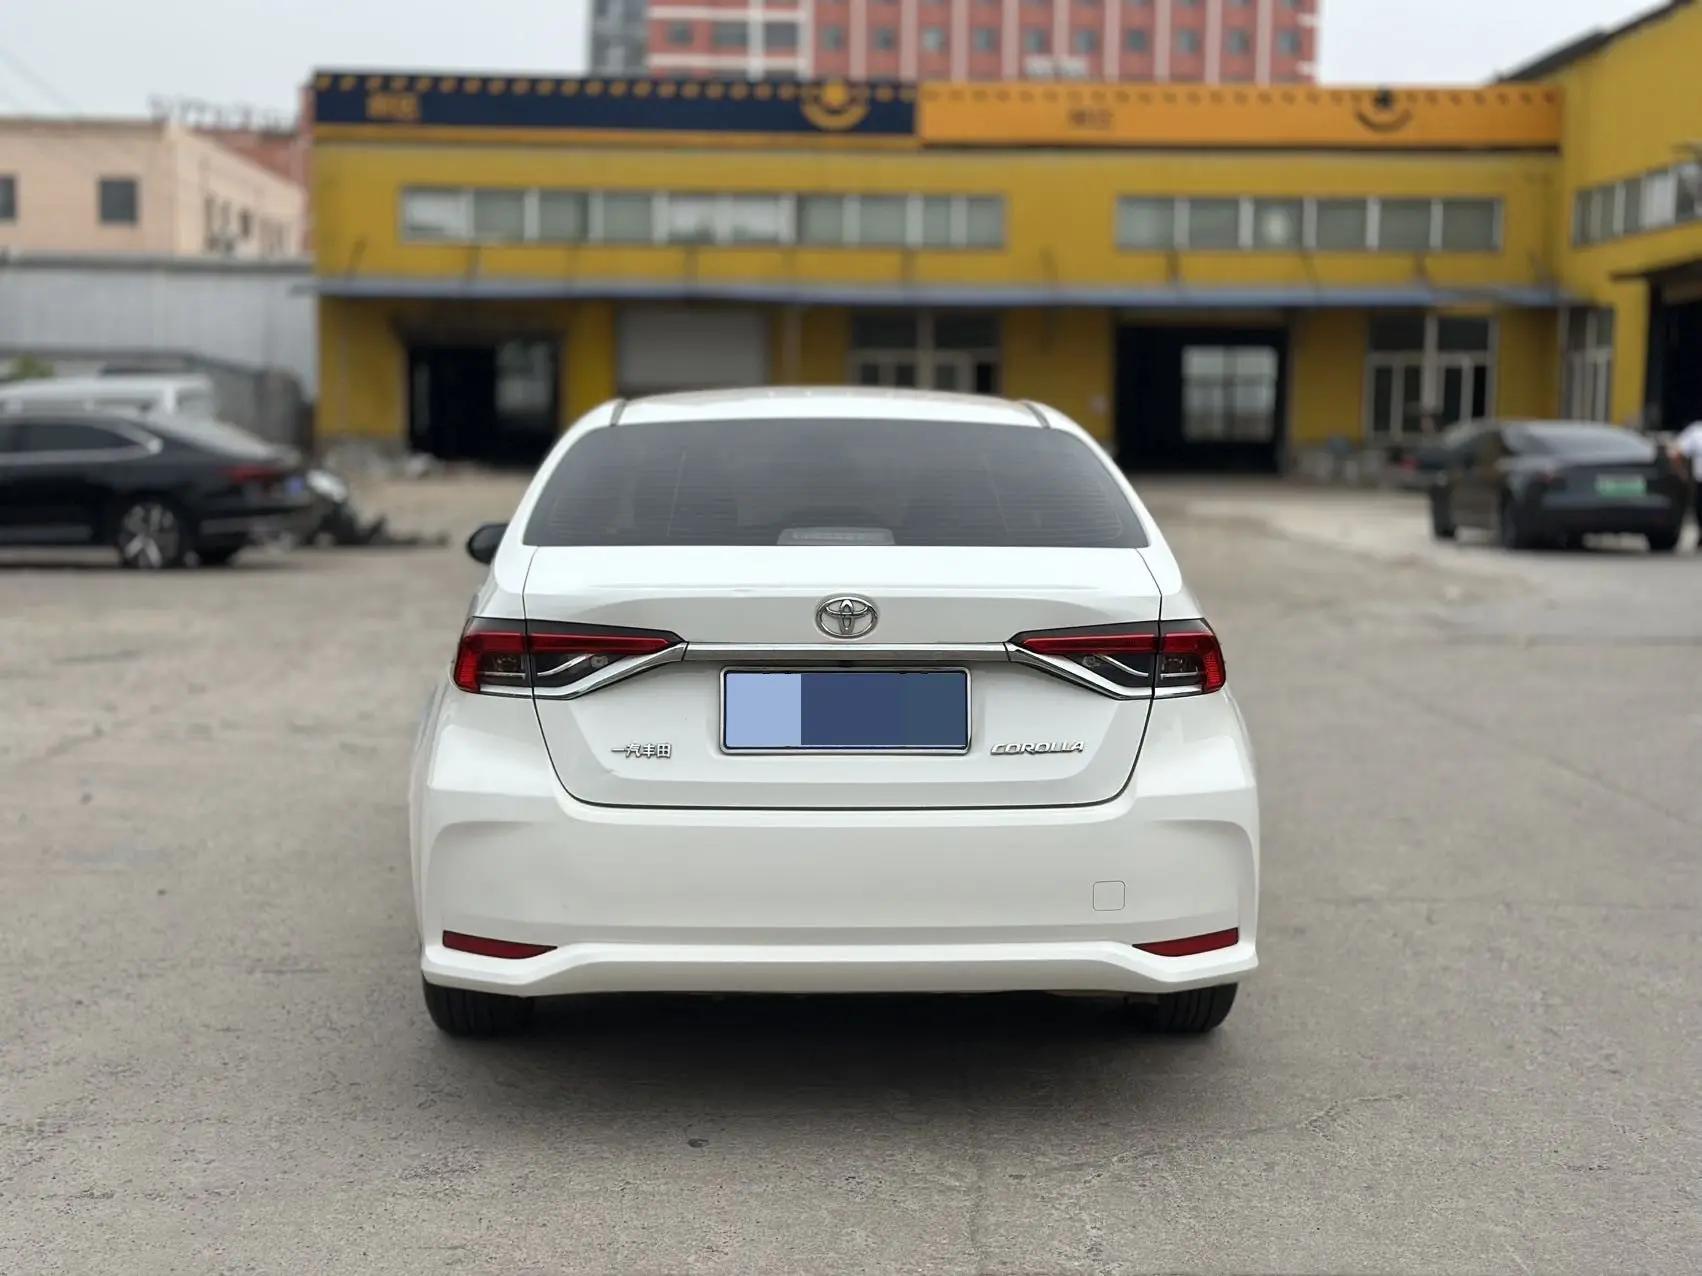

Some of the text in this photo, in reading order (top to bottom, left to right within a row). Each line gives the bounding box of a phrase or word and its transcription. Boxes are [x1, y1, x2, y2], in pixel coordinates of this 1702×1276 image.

[611, 743, 671, 758] 一汽丰田
[990, 742, 1084, 755] COROLLA
